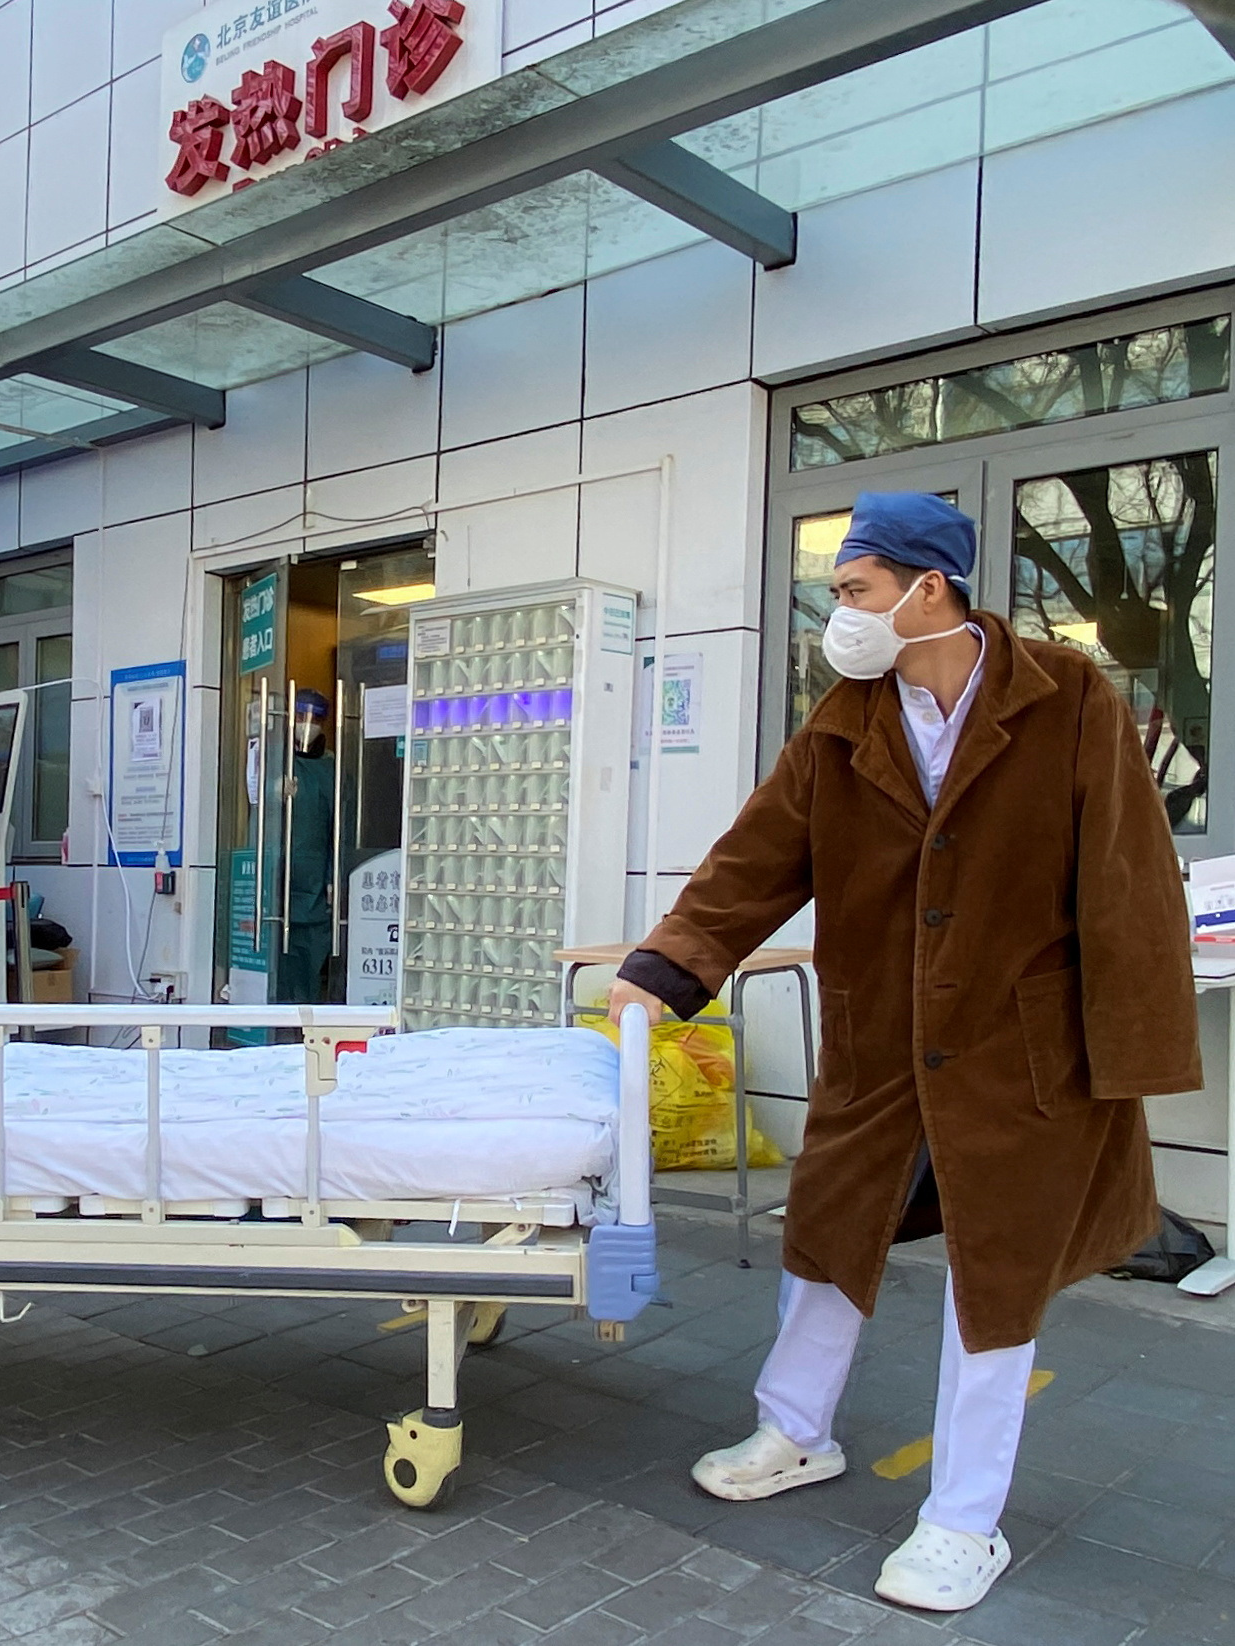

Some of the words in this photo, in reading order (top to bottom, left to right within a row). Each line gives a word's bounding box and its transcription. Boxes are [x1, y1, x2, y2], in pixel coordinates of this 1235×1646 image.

[216, 0, 309, 49] 北京友谊医
[243, 24, 282, 51] FRIENDSHIP
[284, 6, 318, 30] HOSPITAL
[165, 0, 466, 197] 发热门诊
[242, 586, 274, 623] 发热门诊
[362, 958, 393, 976] 6313
